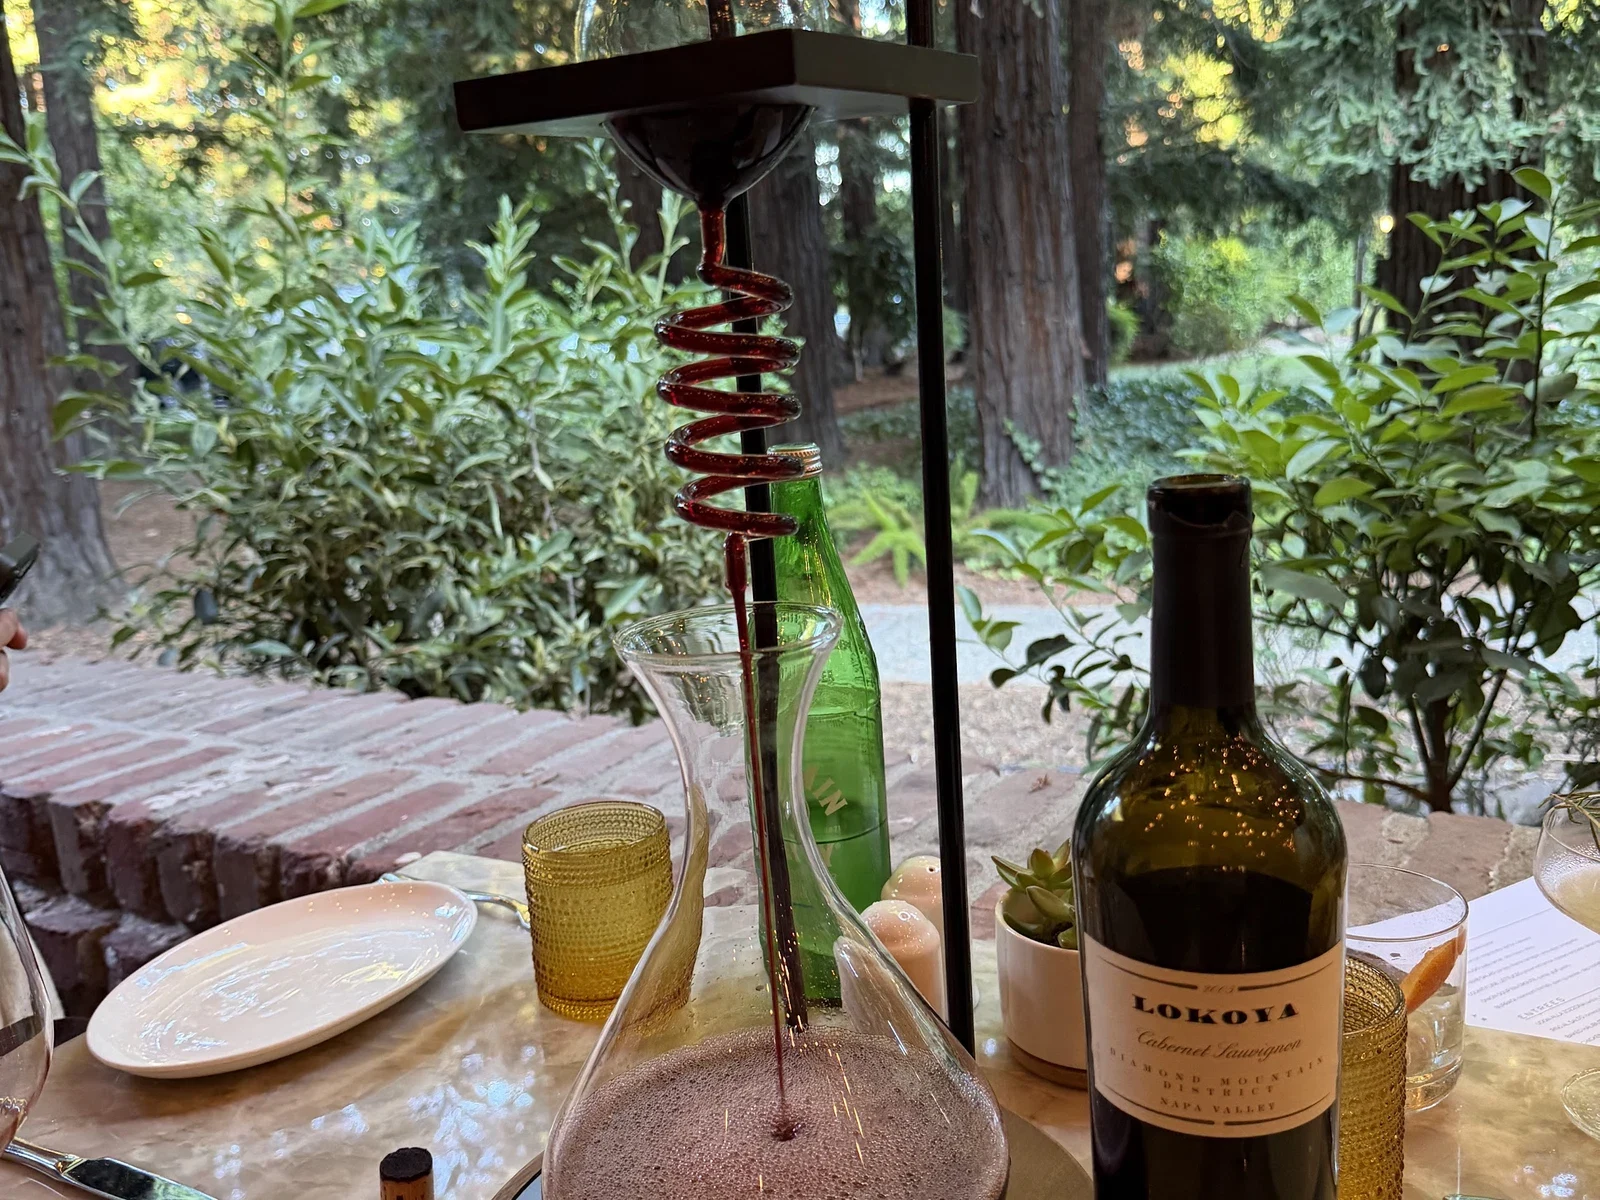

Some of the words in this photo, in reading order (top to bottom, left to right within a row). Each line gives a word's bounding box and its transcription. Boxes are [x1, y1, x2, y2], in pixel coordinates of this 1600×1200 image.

[1132, 993, 1299, 1025] LOKOYA
[1136, 1027, 1211, 1057] Cabernet
[1213, 1039, 1302, 1062] Sauvignon
[1110, 1047, 1200, 1083] DIAMOND
[1221, 1056, 1322, 1086] MOUNTAIN
[1163, 1081, 1273, 1097] DISTRICT
[1160, 1097, 1202, 1112] NAPA
[1213, 1102, 1275, 1114] VALLEY
